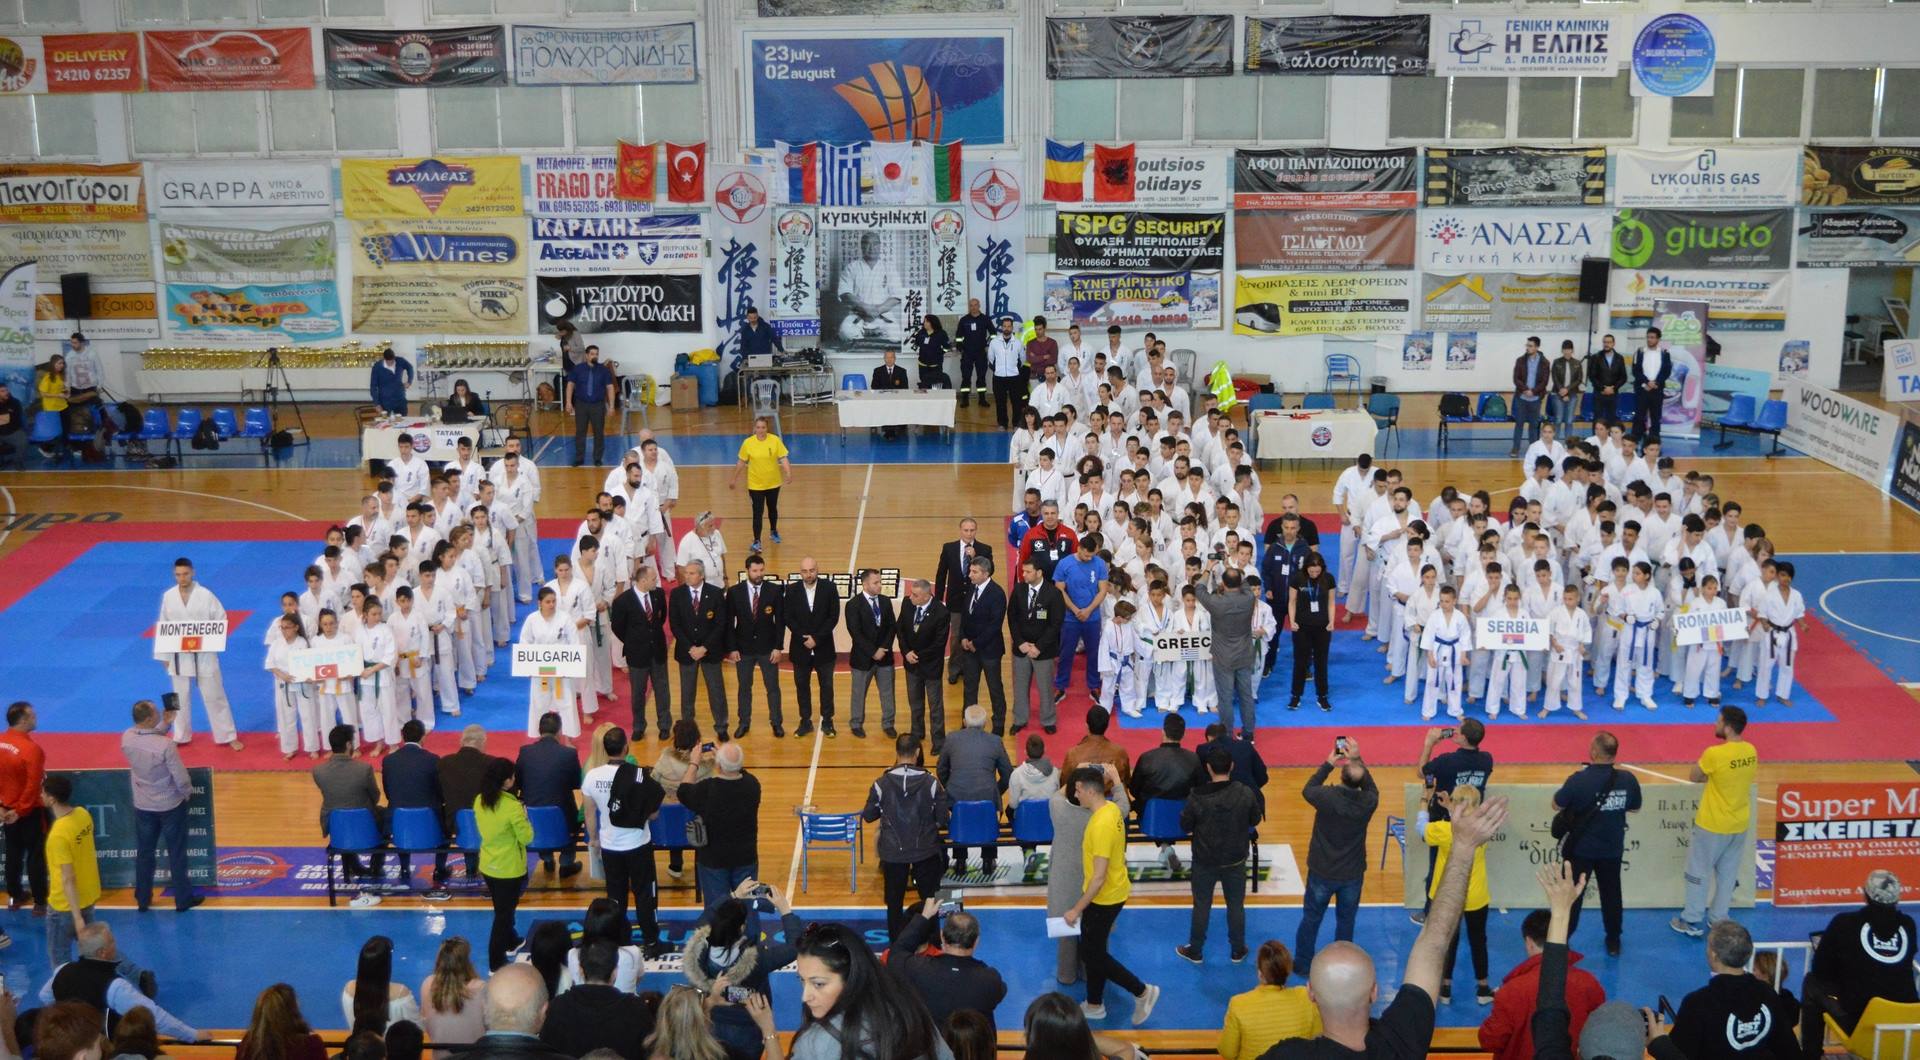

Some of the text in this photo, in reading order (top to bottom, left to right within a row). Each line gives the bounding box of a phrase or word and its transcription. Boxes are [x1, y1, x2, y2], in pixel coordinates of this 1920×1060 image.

[1506, 20, 1609, 32] ΓΕΝΙΚΗ ΚΛΙΝΙΚΗ
[394, 33, 434, 47] STATION
[534, 31, 632, 44] ΦΡΟΝΤΙΣΤΗΡΙΟ
[1505, 34, 1609, 54] Η ΕΛΠΙΣ
[54, 49, 128, 62] DELIVERY
[764, 46, 788, 62] 23
[55, 68, 131, 81] 24210 62357
[764, 65, 836, 82] 02 august
[536, 157, 585, 170] ΜΕΤΑΦΟΡΕΣ
[1135, 157, 1205, 172] outsios
[1247, 156, 1406, 170] ΑΦΟΙ ΠΑΝΤΑΖΟΠΟΥΛΟΙ
[536, 173, 590, 199] FRAGO
[595, 173, 616, 198] CA
[1135, 177, 1203, 195] olidays
[1651, 173, 1761, 185] LYKOURIS GAS
[163, 181, 264, 200] GRAPPA
[268, 181, 294, 189] VINO
[269, 191, 325, 200] APERITIVO
[553, 201, 572, 213] 6945
[821, 210, 927, 227] KYOKUSHINKAI
[1058, 214, 1223, 235] TSPG SECURITY
[537, 218, 641, 237] ΚΑΡΑΛΗΣ
[1074, 237, 1207, 246] ΦΥΛΑΞΗ ΠΕΡΙΠΟΛΙΕΣ
[1665, 220, 1773, 256] giusto
[539, 242, 609, 260] AEGEAN
[1102, 247, 1222, 257] ΧΡΗΜΑΤΑΠΟΣΤΟΛΕΣ
[1057, 258, 1078, 266] 2421
[1118, 258, 1151, 267] ΒΟΛΟΣ
[1432, 251, 1500, 266] Γενική
[1072, 276, 1185, 290] ΣΥΝΕΤΑΙΡΙΣΤΙΚΟ
[1322, 278, 1408, 287] ΛΕΩΦΟΡΕΙΩΝ
[1073, 288, 1160, 301] ΙΚΤΕΟ ΒΟΛΟΥ
[1331, 288, 1357, 297] BUS
[1801, 388, 1880, 436] WOODWARE
[446, 438, 454, 447] A
[1677, 610, 1744, 629] ROMANIA
[160, 622, 225, 636] MONTENEGRO
[1487, 620, 1539, 634] SERBIA
[1157, 637, 1212, 649] GREEC
[292, 649, 358, 665] TURKEY
[517, 651, 582, 662] BULGARIA
[1730, 756, 1757, 769] STAFF
[1781, 787, 1920, 821] Super M
[1780, 840, 1920, 851] ΜΕΛΟΣ ΤΟΥ ΟΜΙΛΟ
[1858, 849, 1920, 858] ΘΕΣΣΑΛΙ
